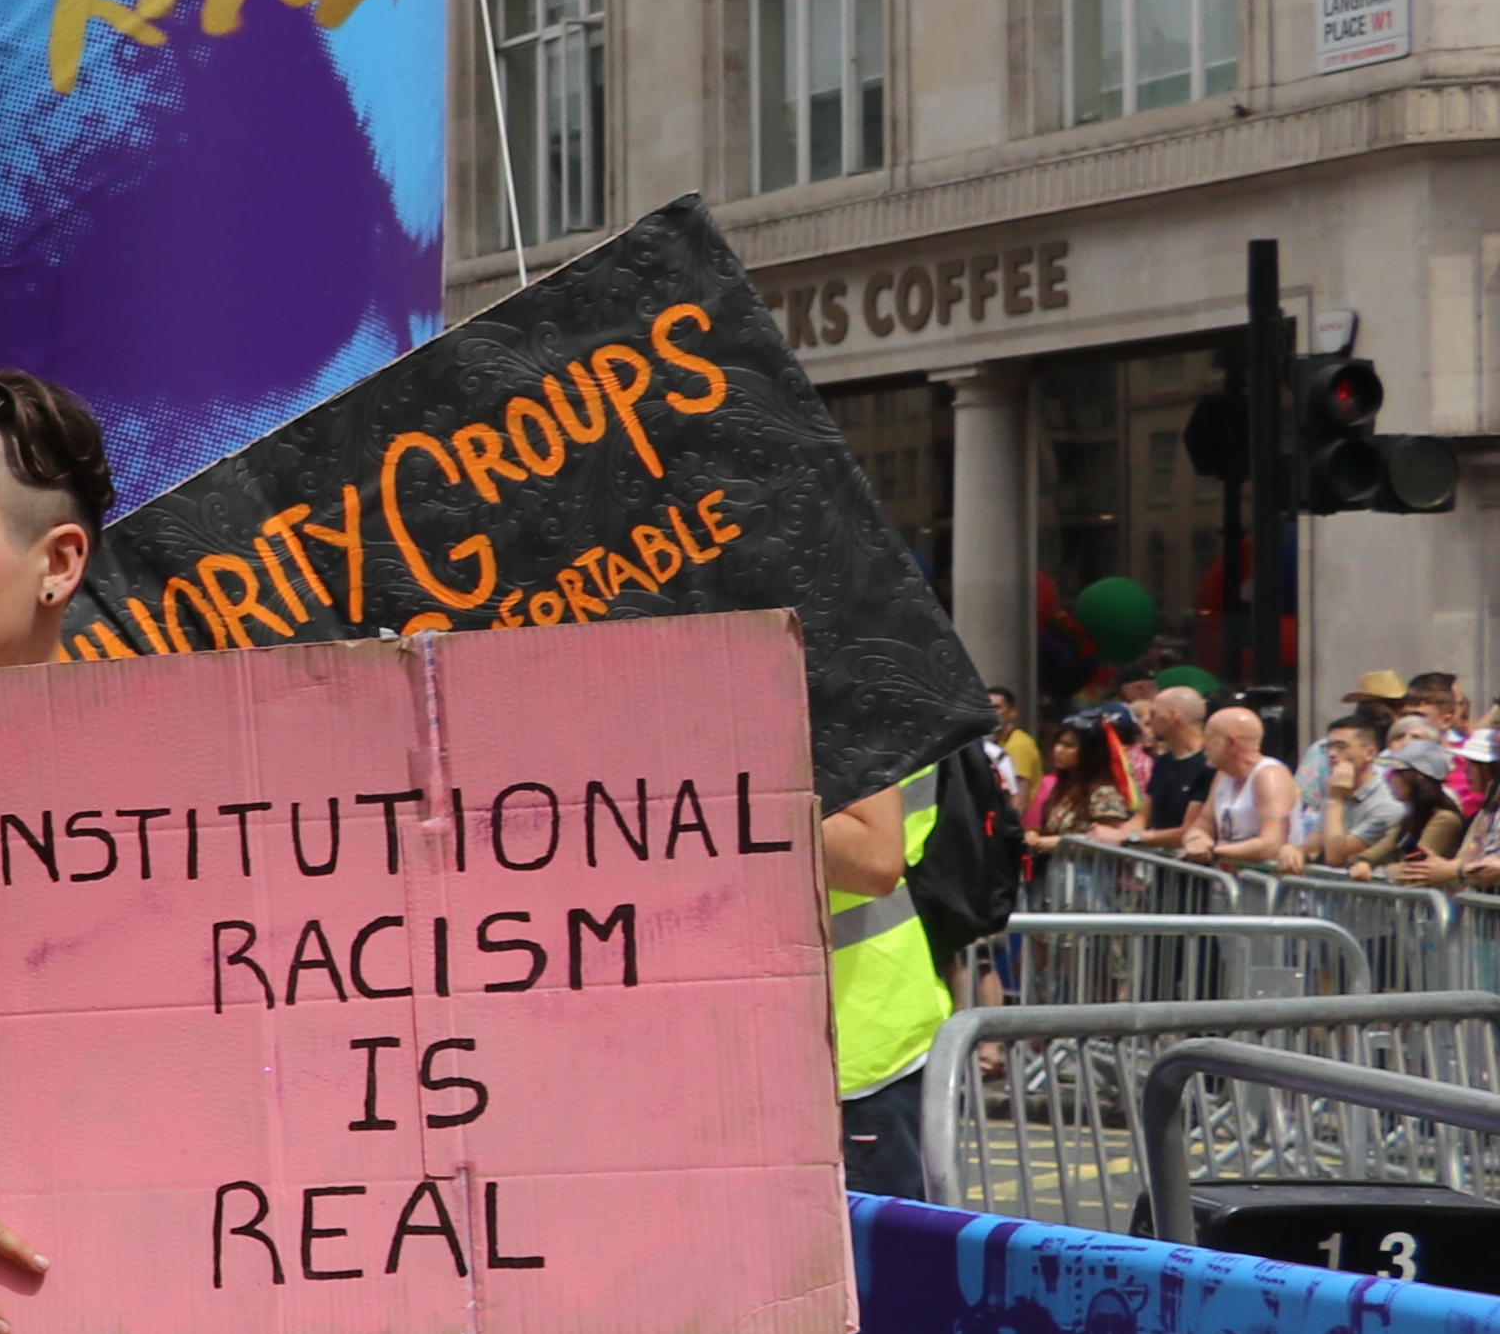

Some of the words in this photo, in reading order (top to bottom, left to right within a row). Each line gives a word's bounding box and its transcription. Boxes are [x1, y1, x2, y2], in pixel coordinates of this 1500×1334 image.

[1324, 14, 1366, 44] PLACE
[1371, 10, 1393, 33] W1
[863, 239, 1069, 337] COFFEE
[381, 303, 728, 611] GROUPS
[212, 903, 639, 1015] RACISM
[348, 1036, 489, 1132] IS
[212, 1180, 546, 1289] REAL
